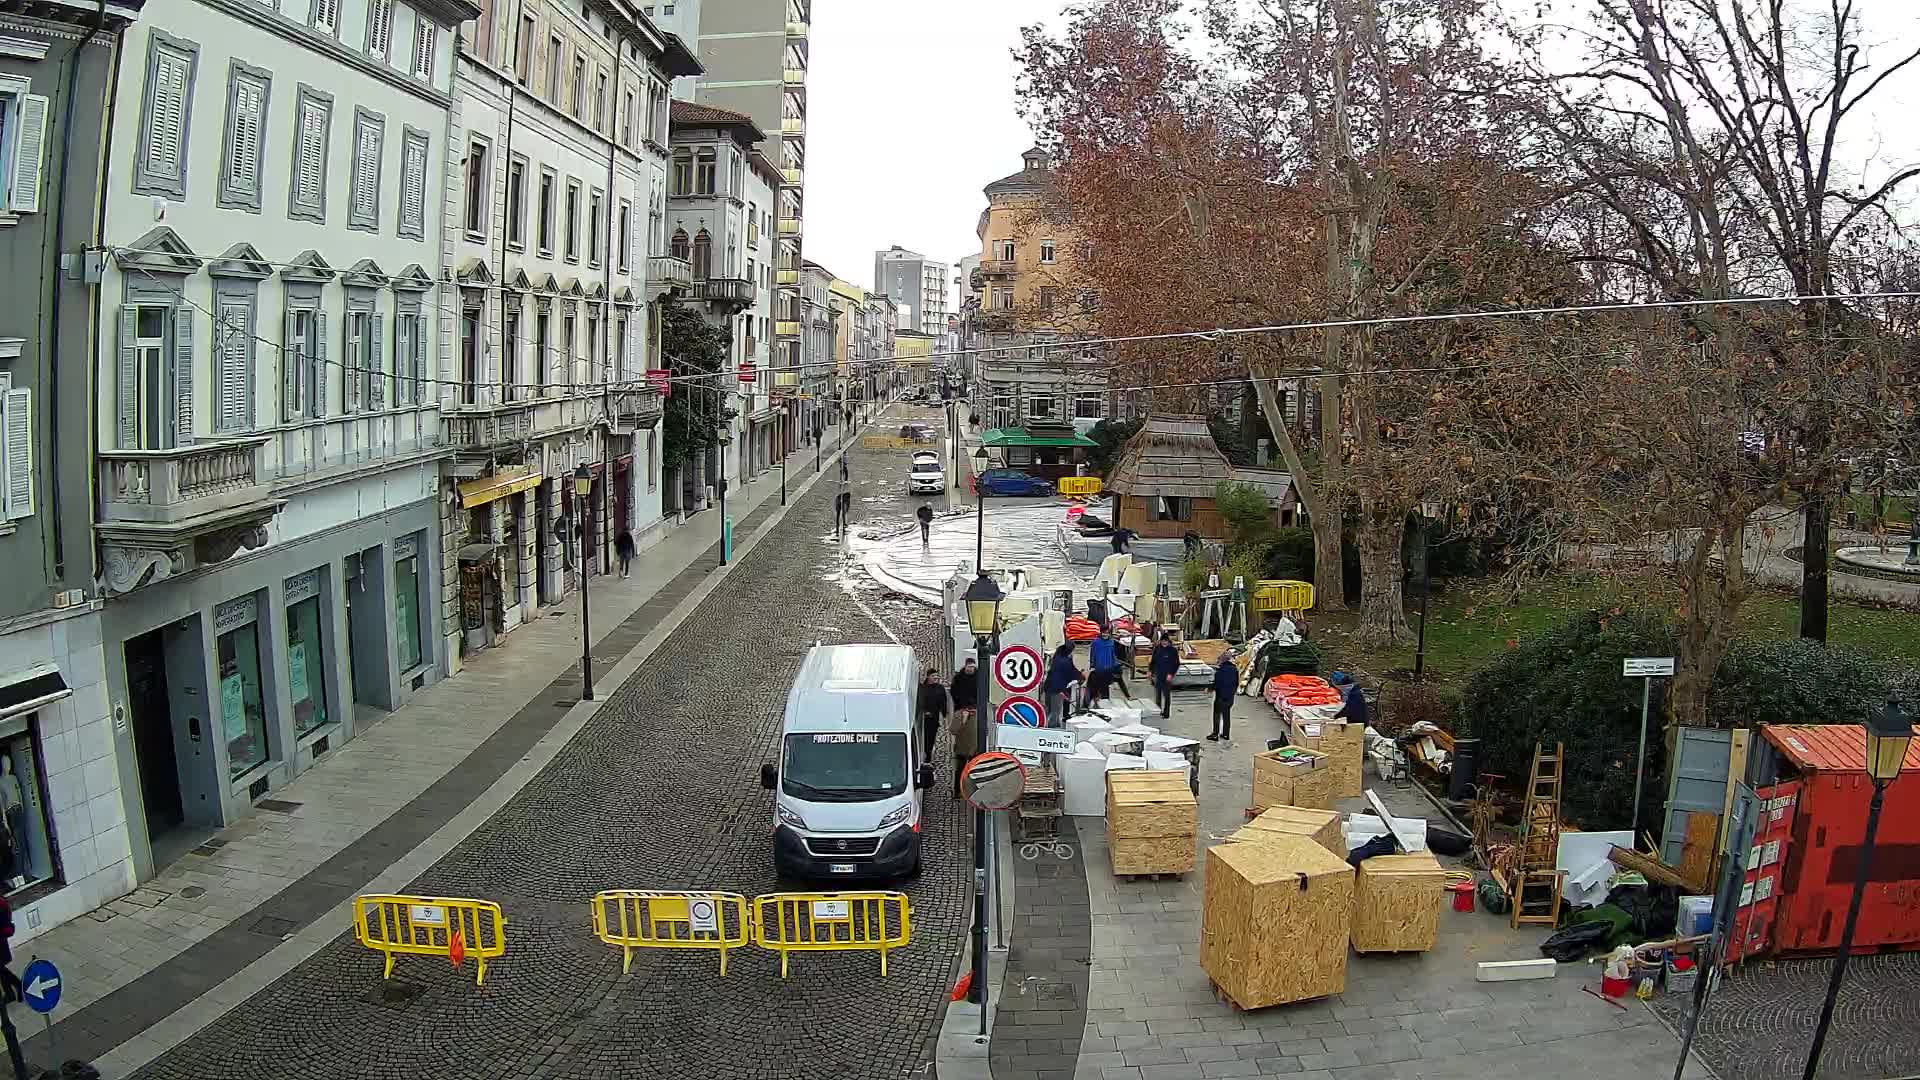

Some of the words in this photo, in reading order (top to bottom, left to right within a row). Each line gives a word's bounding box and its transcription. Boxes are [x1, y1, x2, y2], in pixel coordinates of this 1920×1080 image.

[1006, 658, 1033, 680] 30
[813, 734, 855, 743] PROTEZIONE
[856, 734, 880, 743] CIVILE
[1038, 738, 1069, 749] Dante
